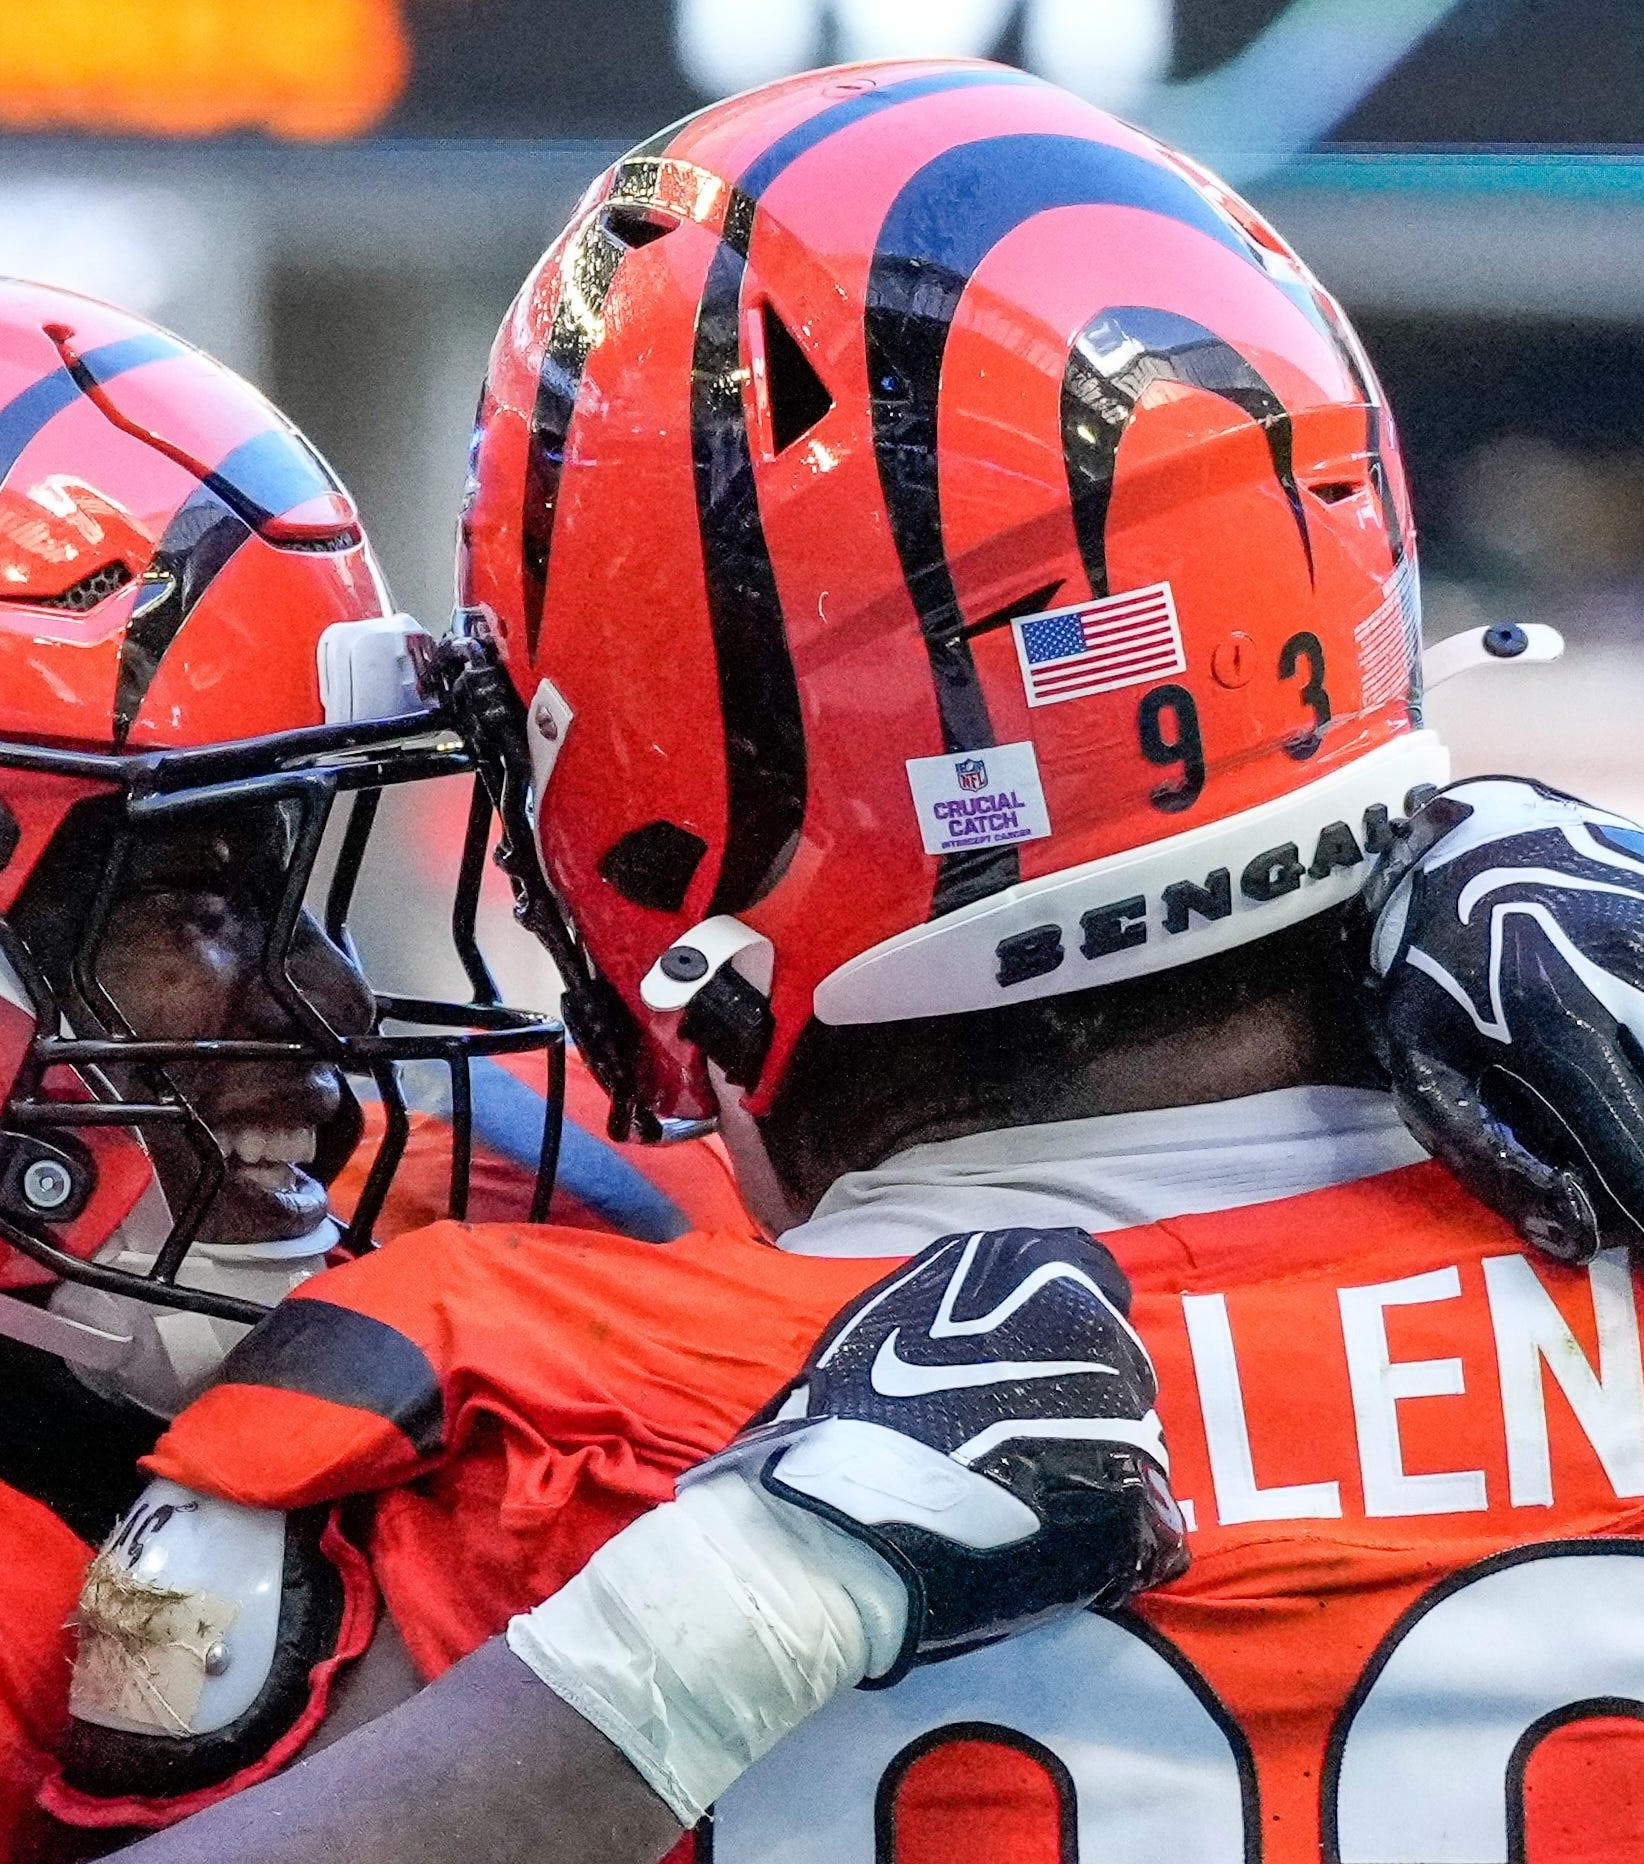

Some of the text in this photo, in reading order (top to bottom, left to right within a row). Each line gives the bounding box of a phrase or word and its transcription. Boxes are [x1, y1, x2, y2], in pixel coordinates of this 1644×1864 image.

[961, 772, 985, 789] NFL
[933, 791, 1026, 820] CRUCIAL
[949, 811, 1019, 837] CATCH
